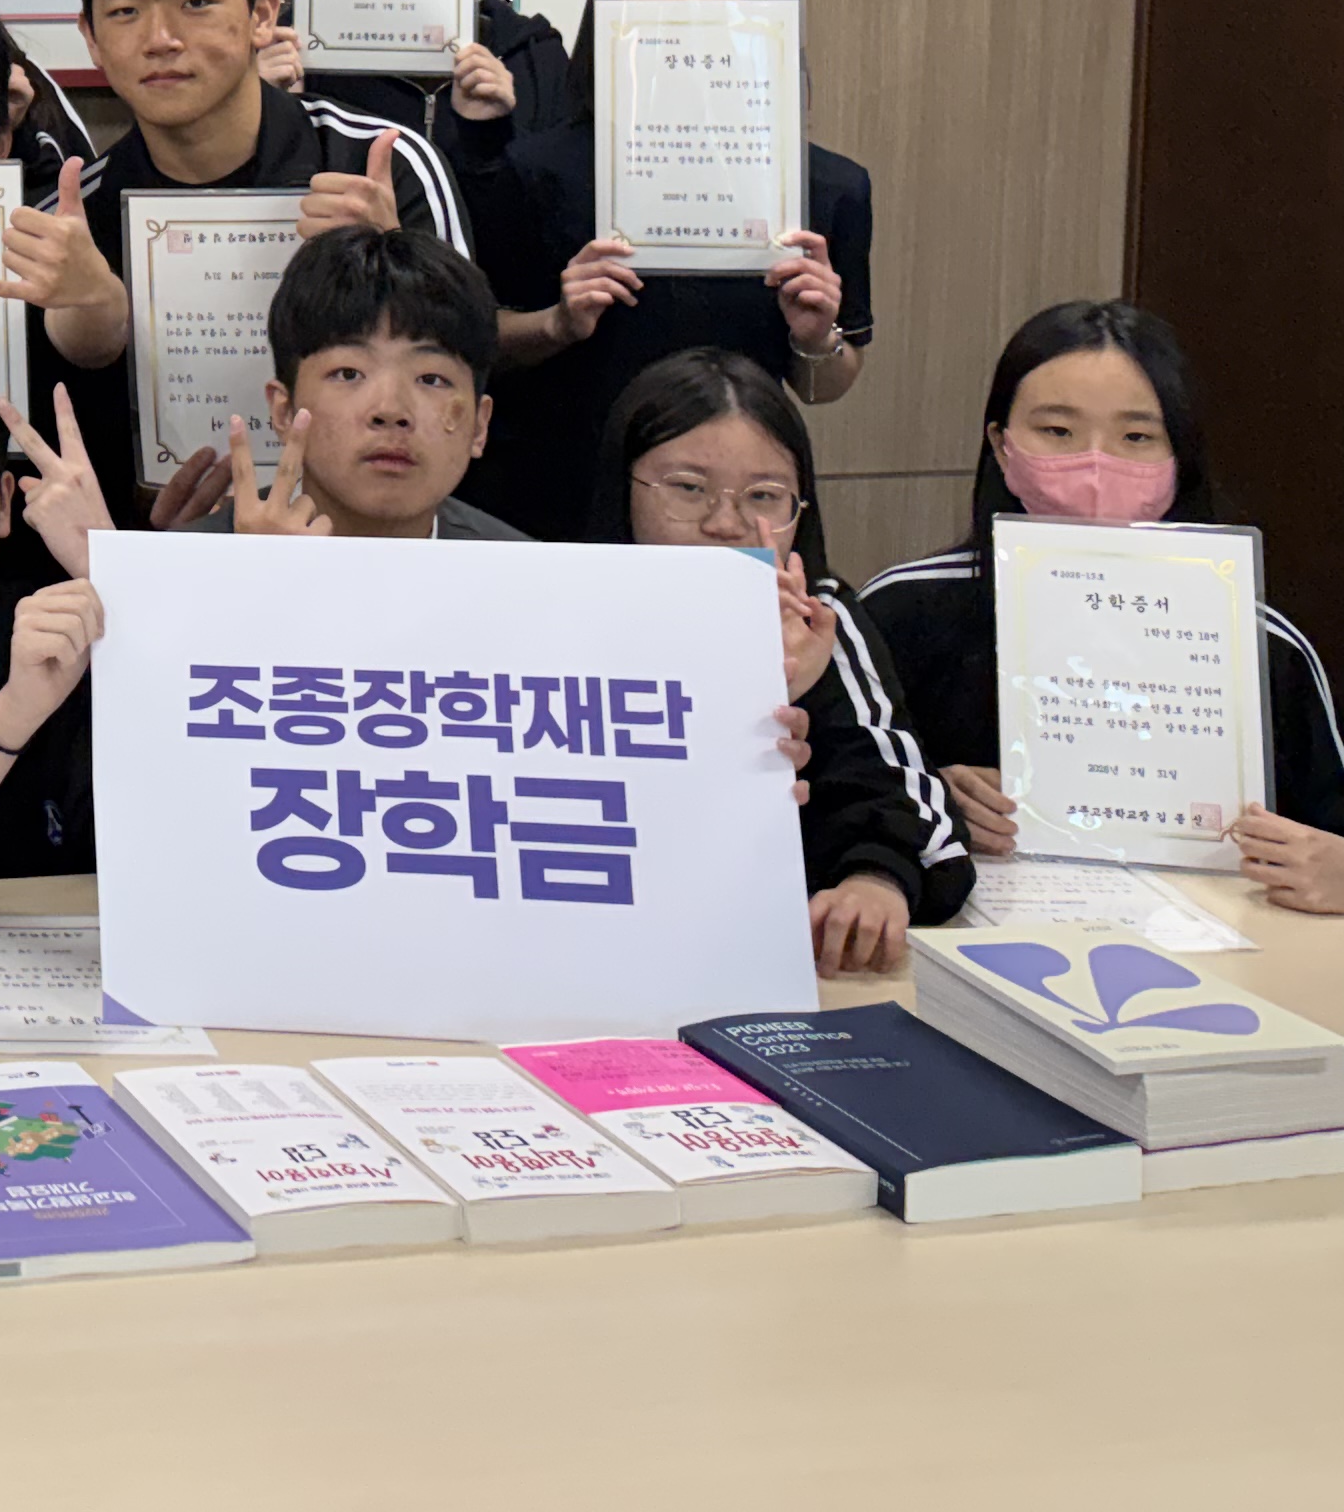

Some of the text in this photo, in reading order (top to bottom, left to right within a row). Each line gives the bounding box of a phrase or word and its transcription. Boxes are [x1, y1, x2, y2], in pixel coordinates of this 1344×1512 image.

[185, 663, 693, 760] 조종장학재단
[250, 766, 637, 905] 장학금
[726, 1021, 814, 1037] PIONEER
[742, 1032, 852, 1046] Conference
[758, 1042, 811, 1057] 2023
[6, 1181, 95, 1197] 기재요령
